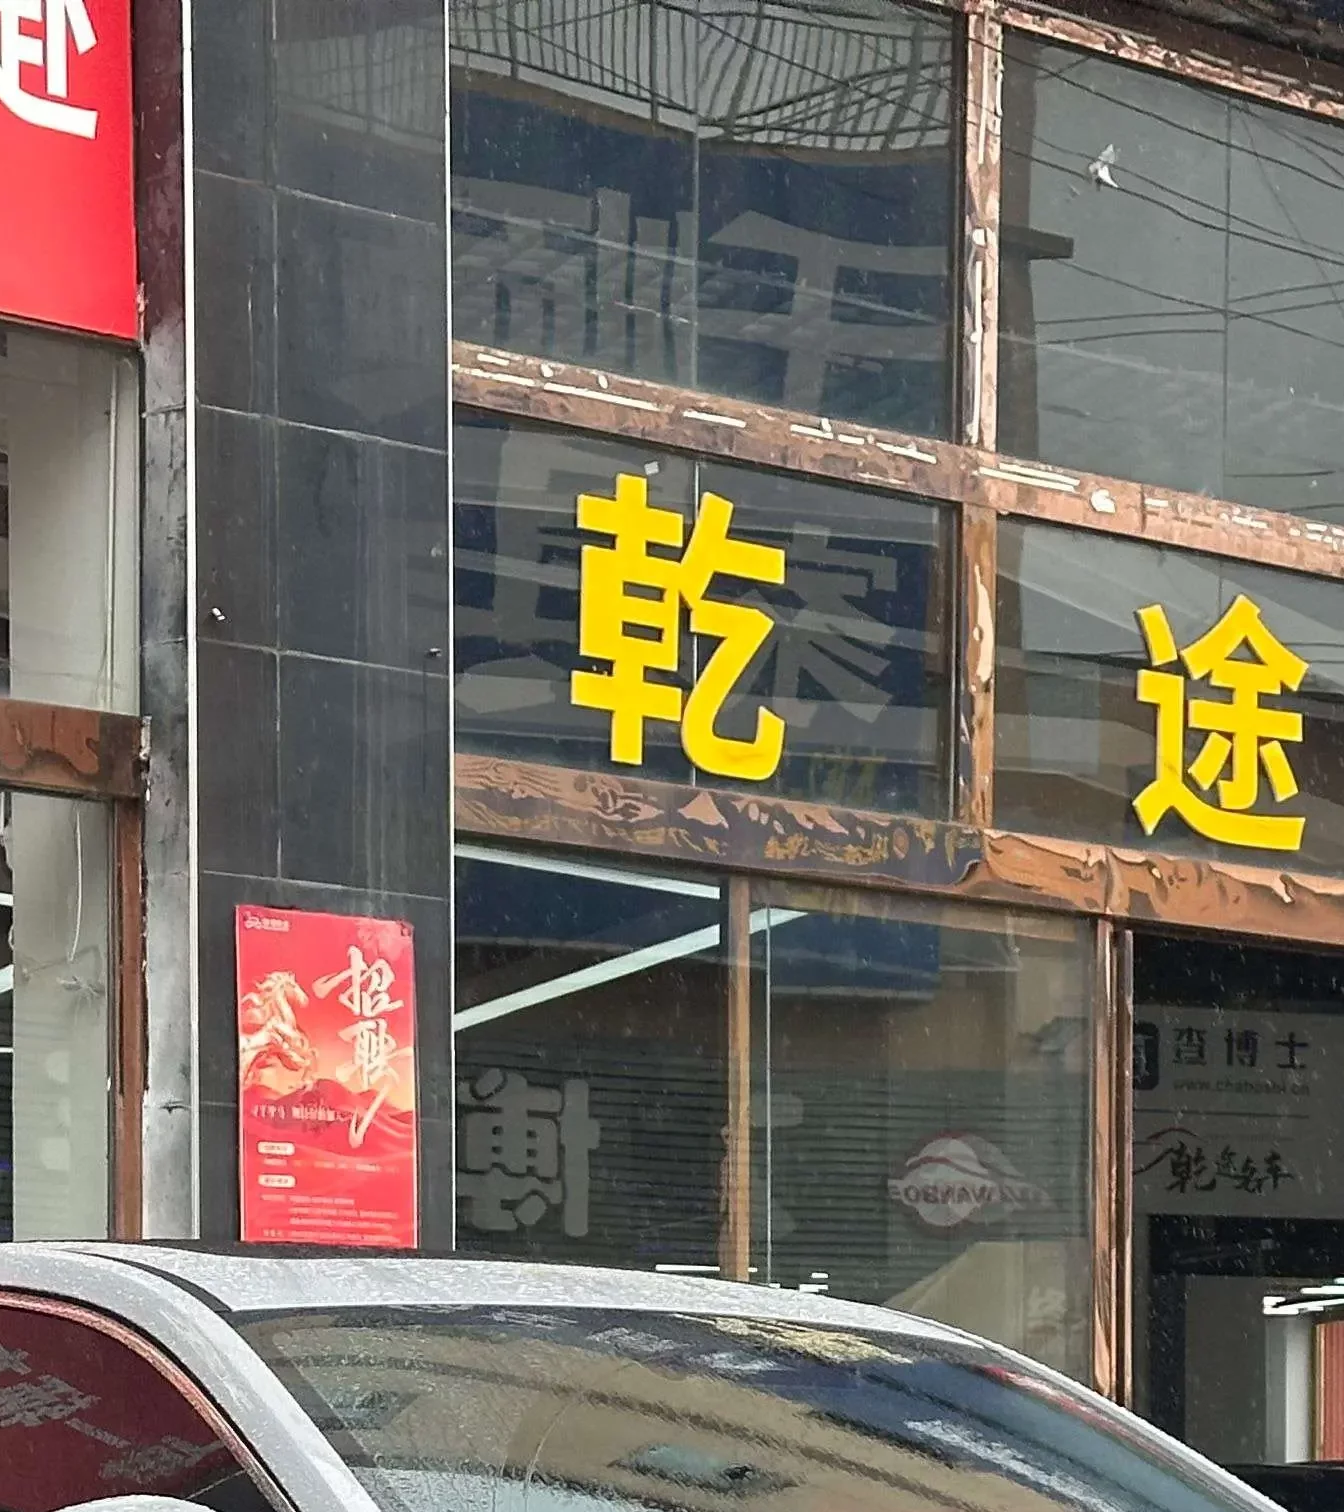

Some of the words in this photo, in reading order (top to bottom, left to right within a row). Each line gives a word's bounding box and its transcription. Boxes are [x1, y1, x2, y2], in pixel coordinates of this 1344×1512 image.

[311, 945, 414, 1149] 招聘
[1172, 1026, 1310, 1069] 查博士
